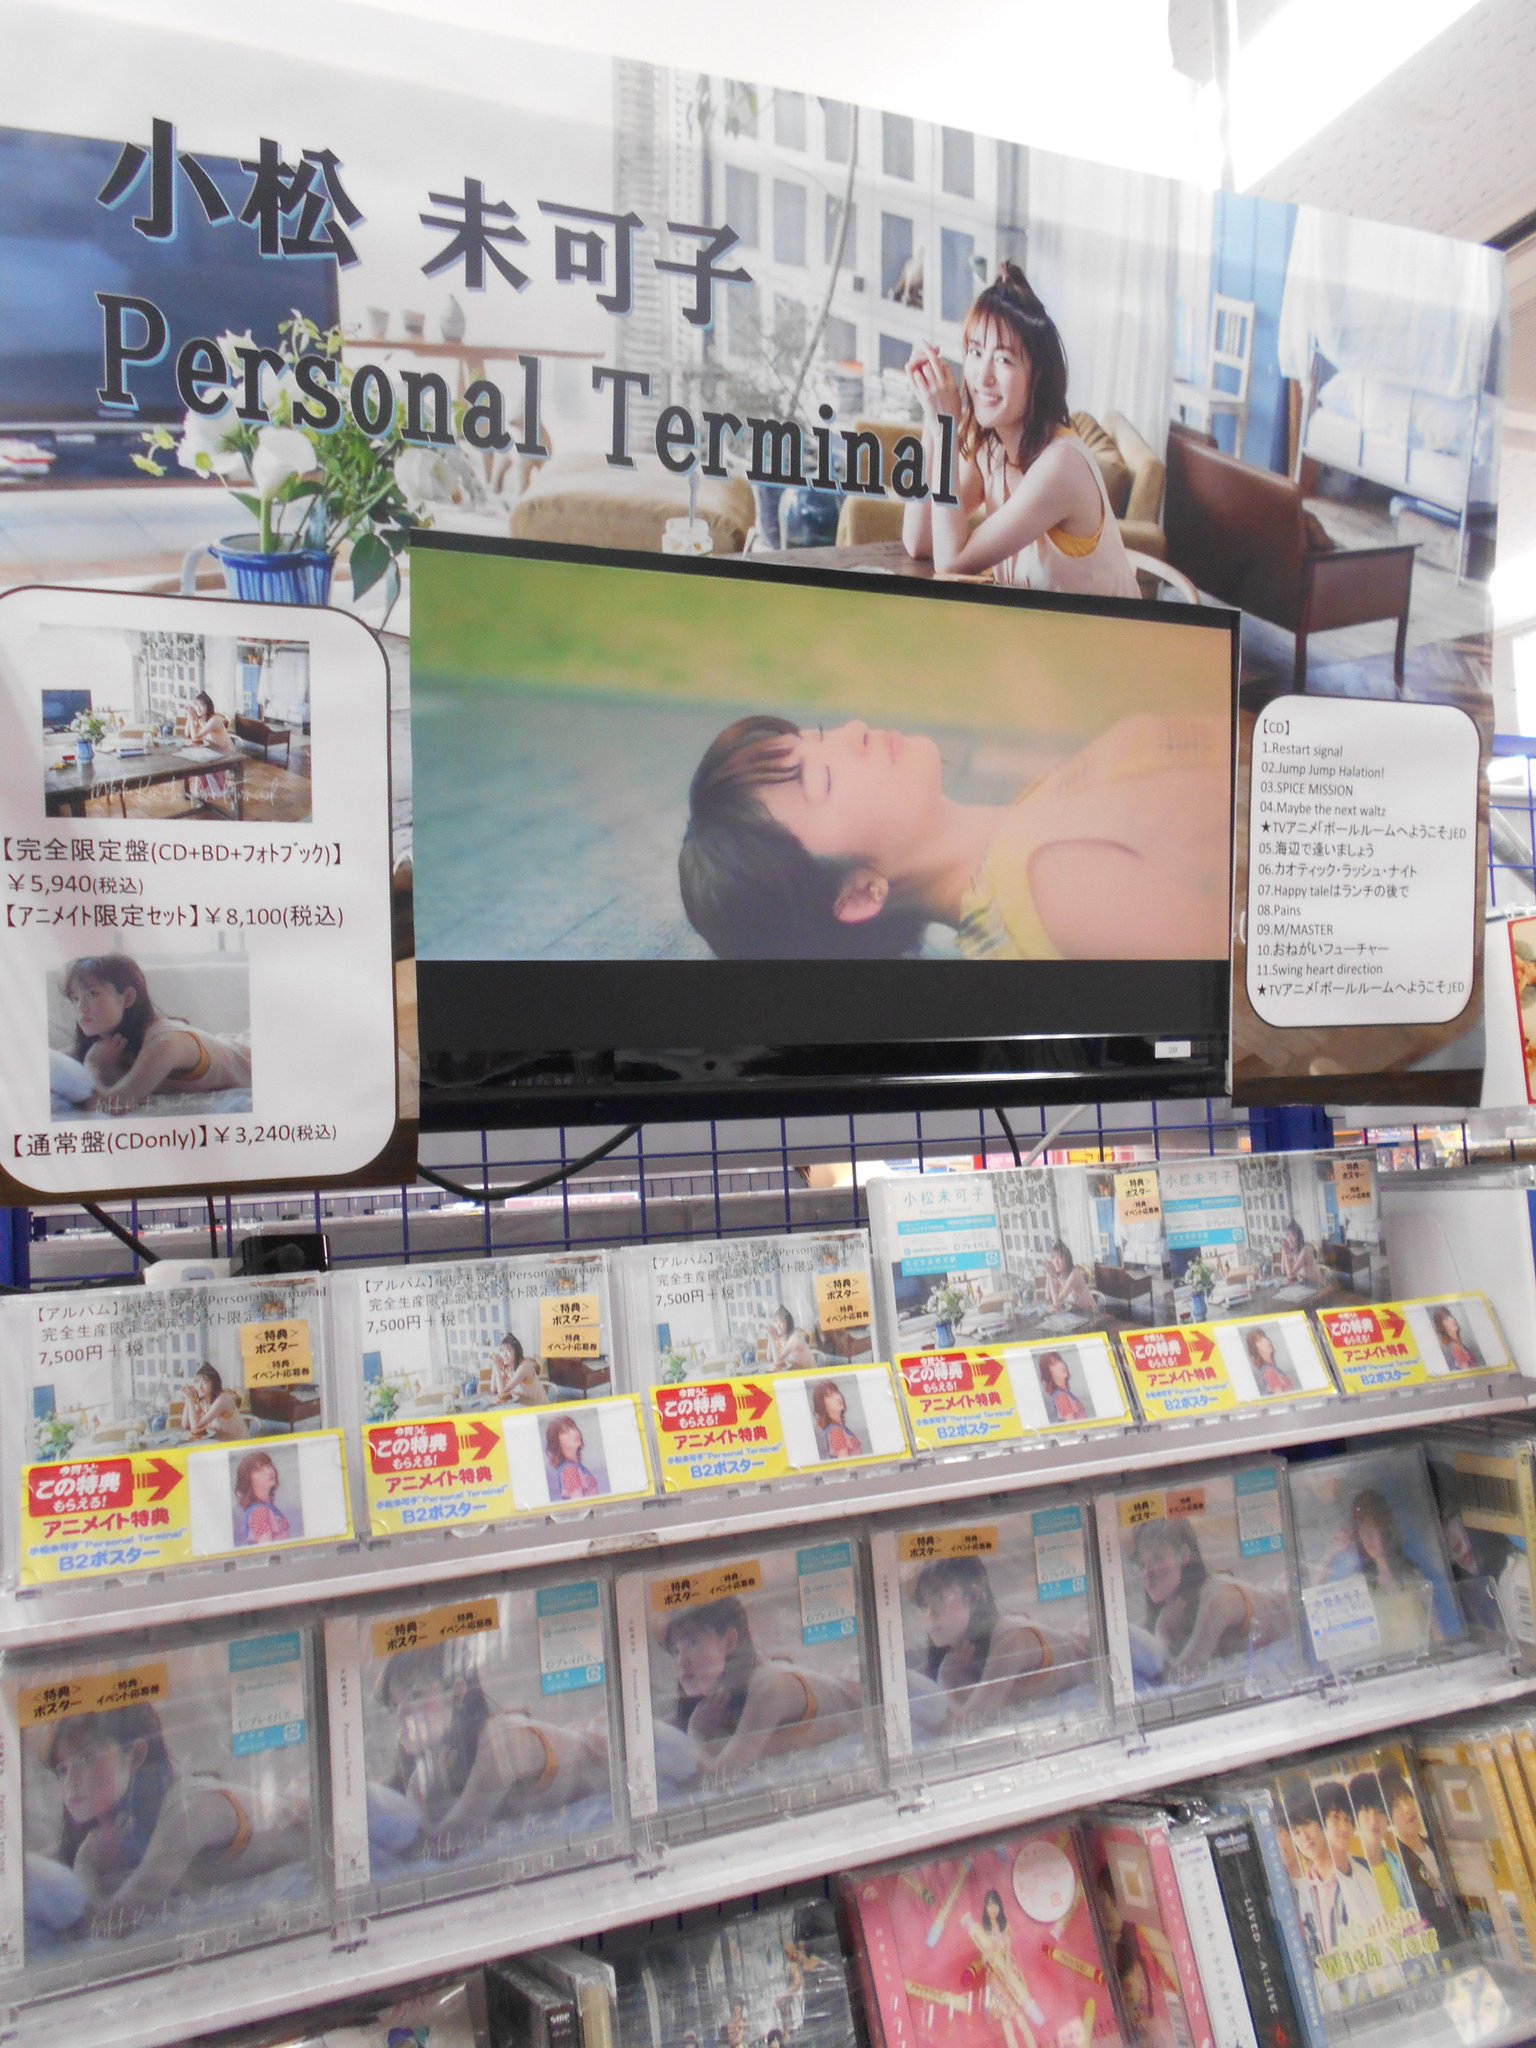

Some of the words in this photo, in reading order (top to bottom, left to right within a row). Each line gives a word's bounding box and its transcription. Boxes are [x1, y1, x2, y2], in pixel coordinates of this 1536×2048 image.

[95, 117, 363, 268] 小松
[419, 176, 757, 328] 未可子
[95, 292, 553, 460] Personal
[592, 364, 960, 505] Terminal
[1262, 742, 1310, 756] 1.Restart
[1313, 745, 1343, 759] signal
[1261, 761, 1306, 777] 02.Jump
[1308, 764, 1336, 778] Jump
[1339, 765, 1385, 779] Halation!
[1260, 781, 1305, 794] 03.SPICE
[1308, 783, 1354, 796] MISSION
[1260, 801, 1312, 816] 04.Maybe
[1314, 803, 1332, 815] the
[1335, 805, 1357, 816] next
[1360, 805, 1386, 817] waltz
[1258, 884, 1307, 898] 07.Happy
[1257, 904, 1301, 916] 08.Pains
[1257, 924, 1333, 935] 09.M/MASTER
[1257, 964, 1303, 977] 11.Swing
[1306, 964, 1334, 975] heart
[1336, 963, 1383, 975] direction
[552, 1315, 589, 1326] ポスター
[256, 1342, 298, 1354] ポスター
[908, 1361, 963, 1384] この特典
[1146, 1366, 1216, 1387] アニメイト特典
[664, 1394, 726, 1418] この特典
[920, 1391, 1002, 1413] アニメイト特典
[674, 1425, 768, 1450] アニメイト特典
[937, 1422, 1000, 1439] B2ポスター
[376, 1433, 447, 1458] この特典
[690, 1459, 765, 1479] B2ポスター
[35, 1471, 121, 1500] この特典
[385, 1466, 492, 1494] アニメイト特典
[53, 1496, 107, 1513] もらえる!
[402, 1502, 487, 1525] B2ポスター
[43, 1507, 170, 1539] アニメイト特典
[58, 1547, 160, 1572] B2ポスター
[387, 1634, 428, 1651] ポスター
[34, 1700, 83, 1718] ポスター
